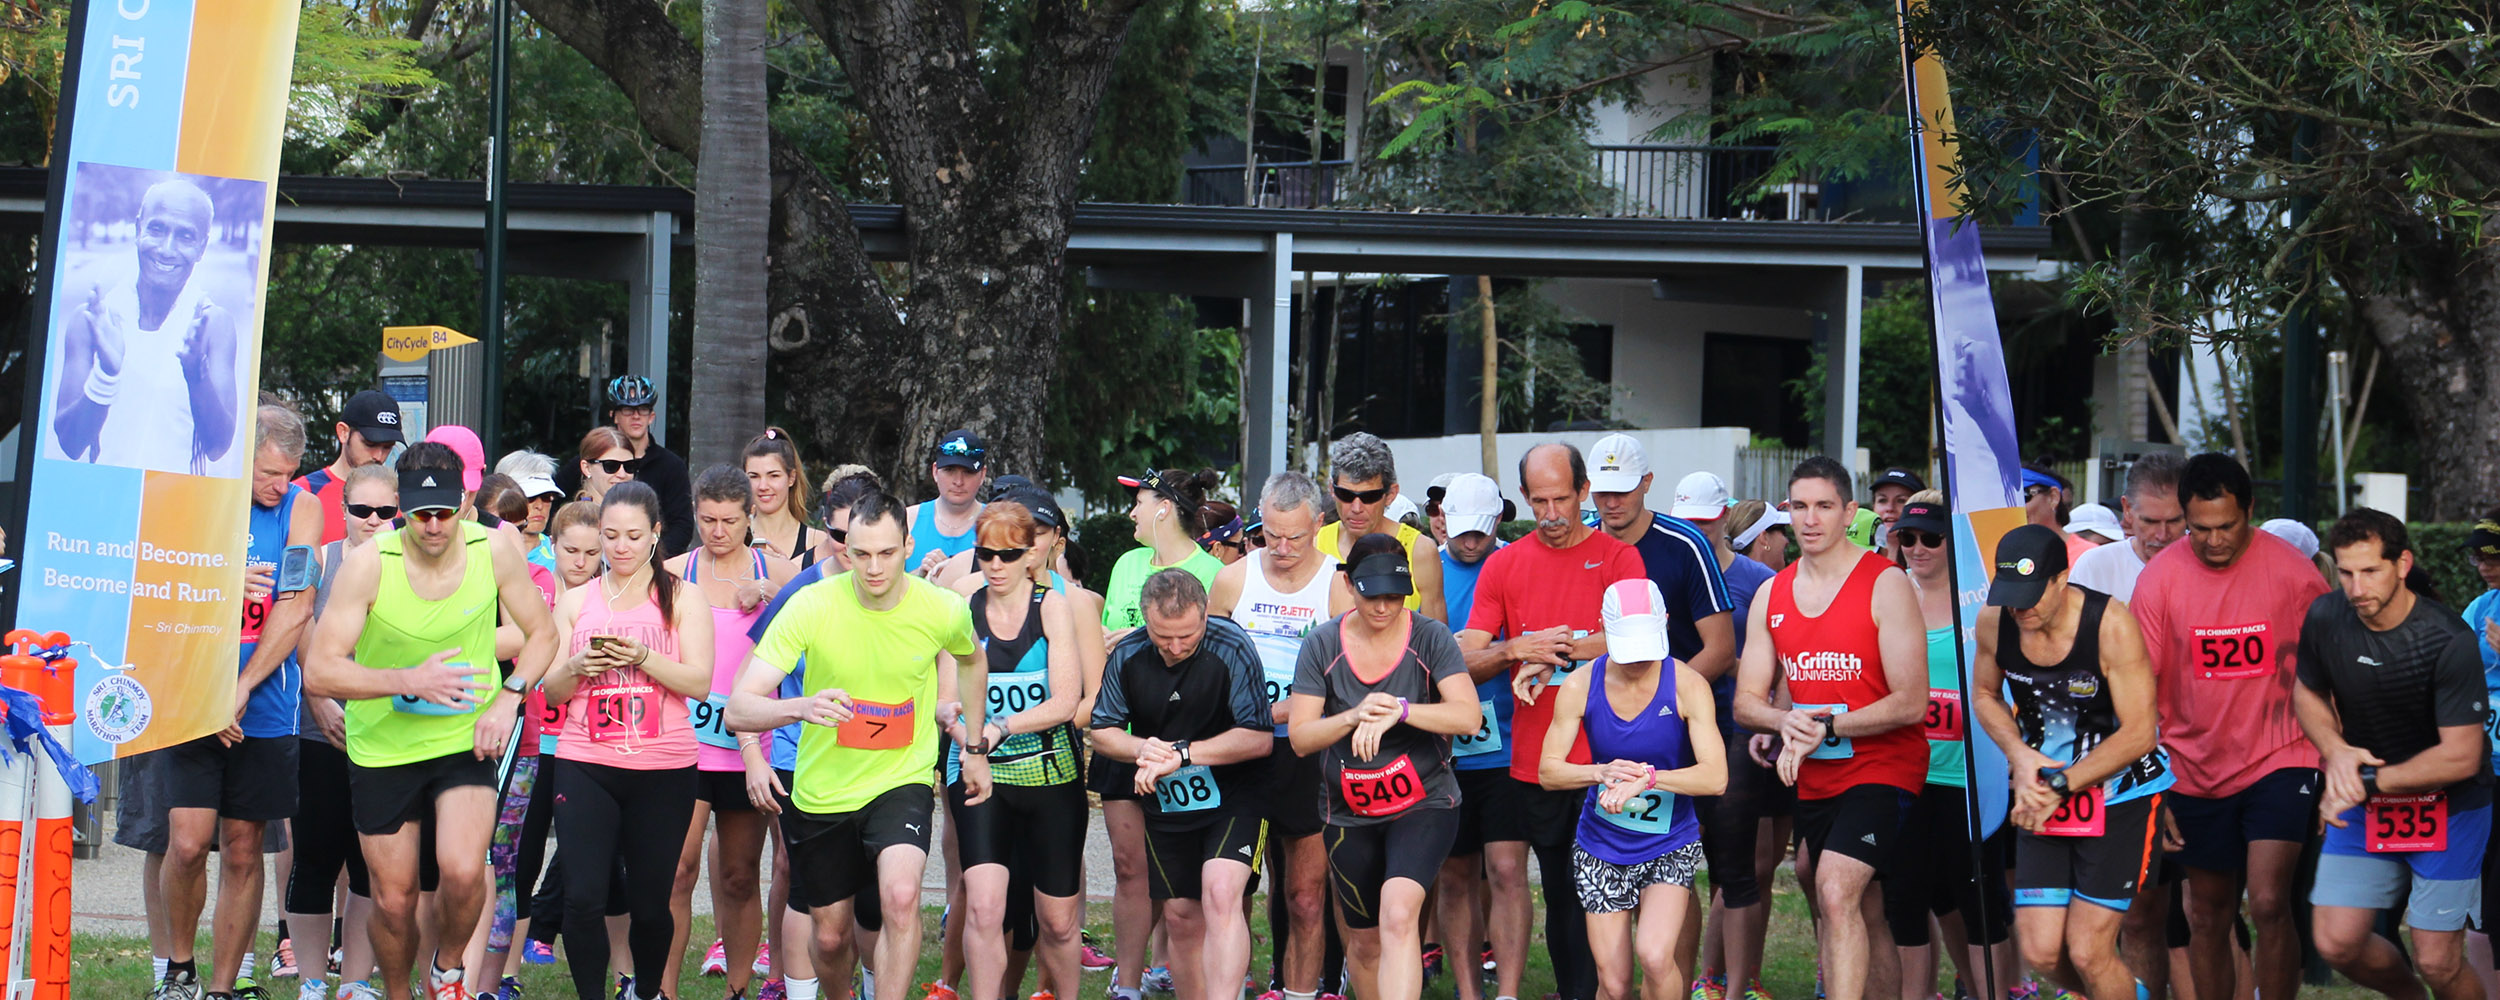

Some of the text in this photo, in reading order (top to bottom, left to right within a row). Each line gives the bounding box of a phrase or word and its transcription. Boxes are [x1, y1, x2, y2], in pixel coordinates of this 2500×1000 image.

[107, 35, 146, 110] SRI
[386, 331, 447, 352] CityCycle 84
[47, 531, 229, 568] Run and Become.
[44, 567, 227, 602] Become and Run.
[156, 621, 173, 633] Sri
[174, 622, 223, 636] Chinmoy
[2206, 627, 2242, 637] CHINMOY
[2242, 624, 2266, 634] RACES
[1797, 651, 1862, 670] Griffith
[2201, 635, 2264, 668] 520
[1265, 671, 1293, 680] CHINMO
[1798, 669, 1862, 681] UNIVERSITY
[92, 677, 147, 701] SRI CHINMOY
[988, 683, 1047, 714] 909
[1942, 692, 1960, 700] RACE
[597, 696, 645, 727] 519
[694, 701, 737, 737] 91
[856, 703, 892, 718] CHINMOY
[893, 701, 915, 718] RACES
[86, 709, 122, 742] MARATHON
[130, 713, 149, 735] TEAM
[865, 720, 888, 739] 7
[1354, 771, 1385, 780] CHINMOY
[1385, 759, 1407, 776] RACES
[1156, 775, 1212, 807] 908
[1349, 773, 1412, 807] 540
[2377, 805, 2437, 839] 535
